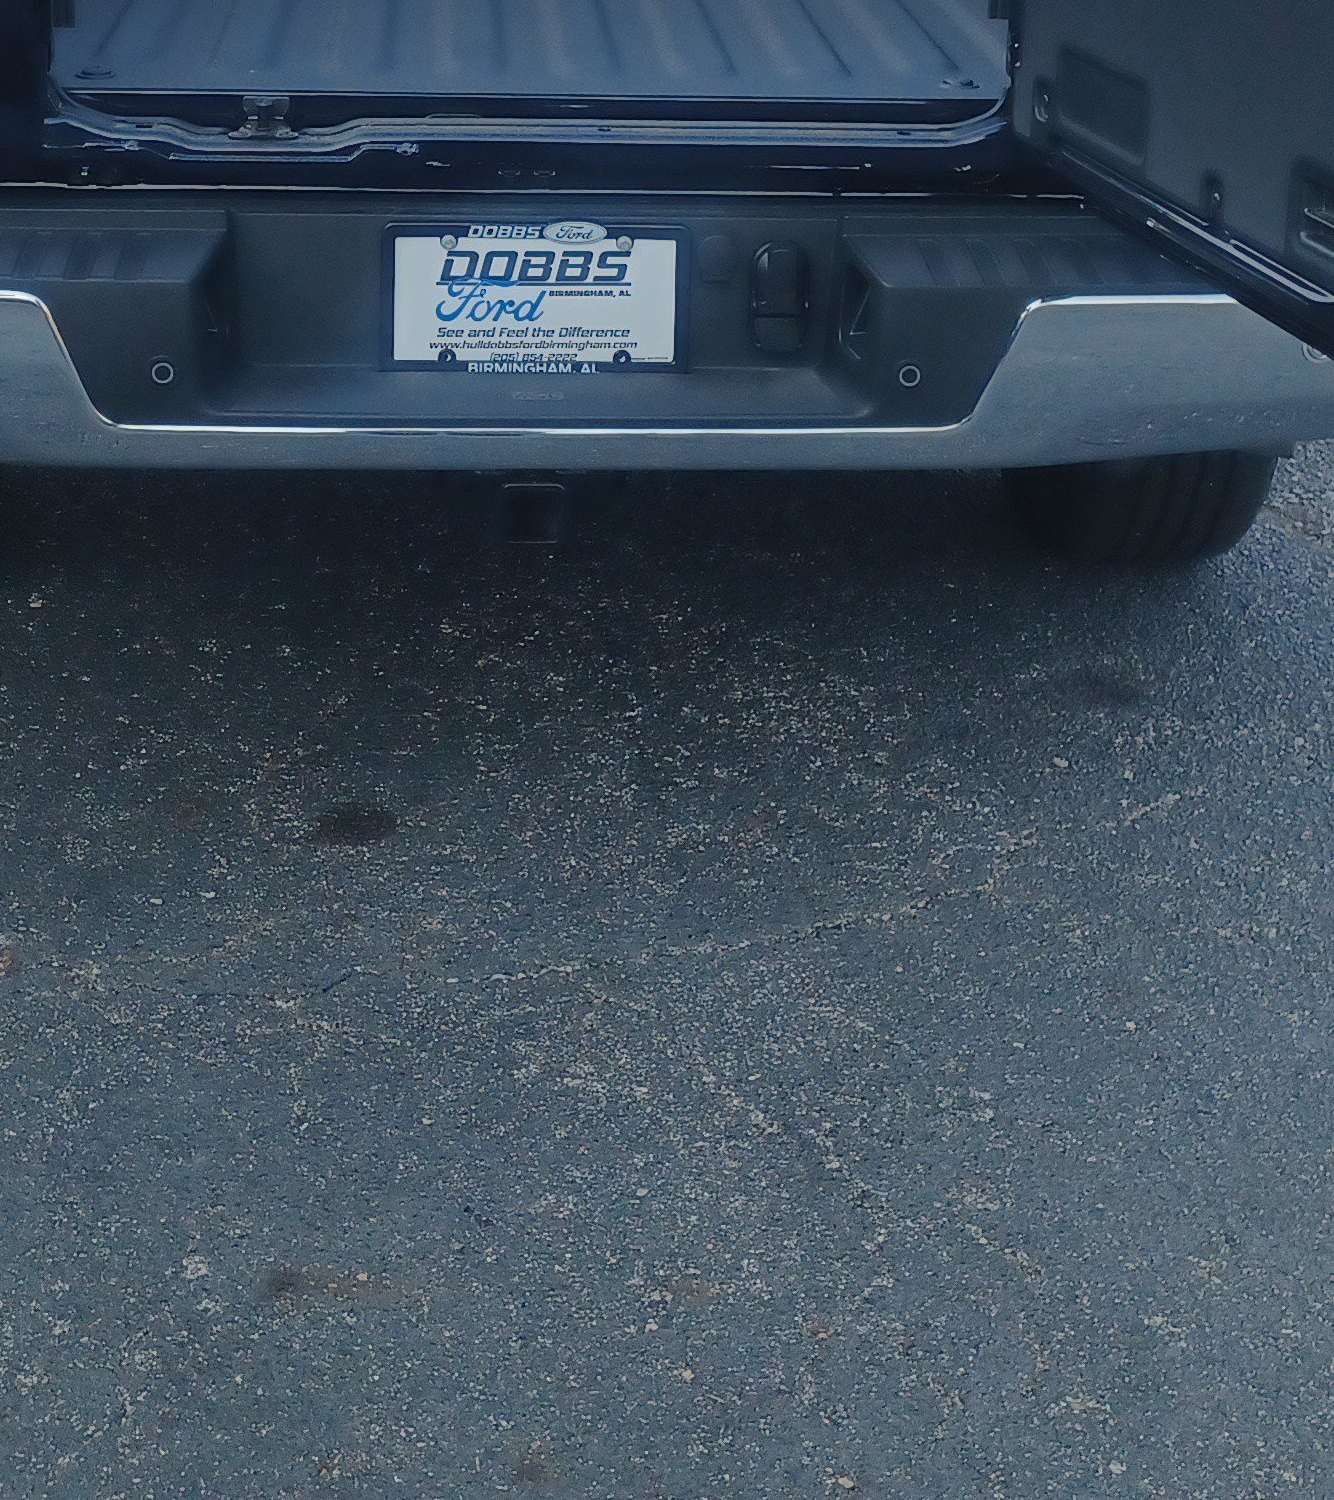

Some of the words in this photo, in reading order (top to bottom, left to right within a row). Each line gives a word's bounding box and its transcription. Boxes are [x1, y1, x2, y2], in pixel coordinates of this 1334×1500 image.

[467, 225, 542, 239] DOBBS
[440, 250, 632, 282] DOBBS
[435, 277, 547, 322] Ford
[548, 290, 616, 298] BIRMINGHAM,
[437, 327, 464, 338] See
[468, 327, 496, 338] and
[499, 327, 529, 338] Feel
[531, 327, 555, 338] the
[558, 327, 631, 338] Difference
[429, 340, 638, 351] www.hulldobbsfordbirmingham.com
[580, 362, 600, 374] AL
